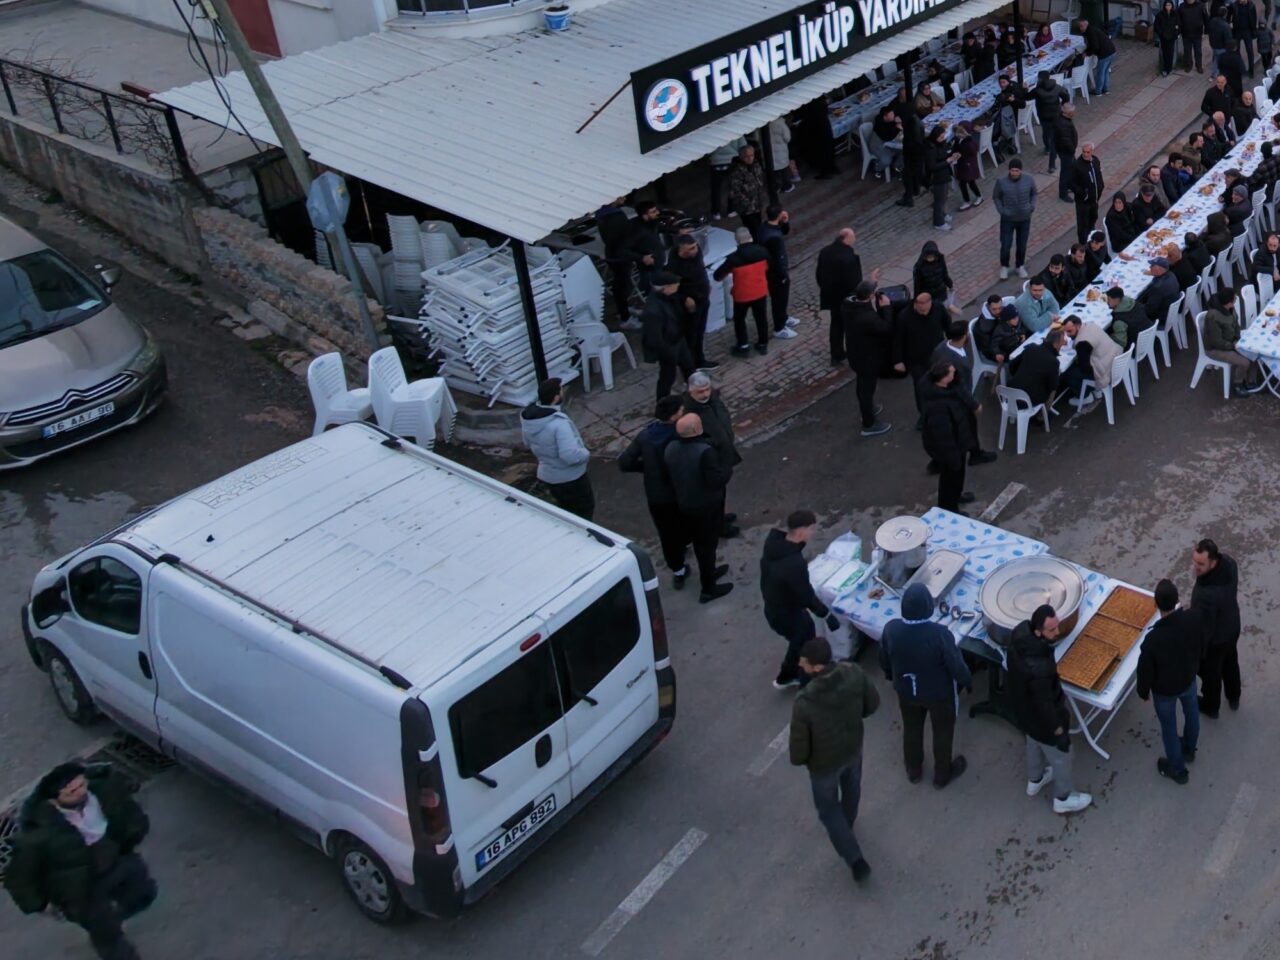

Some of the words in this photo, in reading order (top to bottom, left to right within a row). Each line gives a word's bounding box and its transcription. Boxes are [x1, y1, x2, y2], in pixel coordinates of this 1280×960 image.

[690, 1, 855, 113] TEKNELİKÜP
[51, 422, 65, 432] 16
[487, 841, 501, 858] 16
[504, 821, 527, 846] APG
[530, 800, 552, 824] 892
